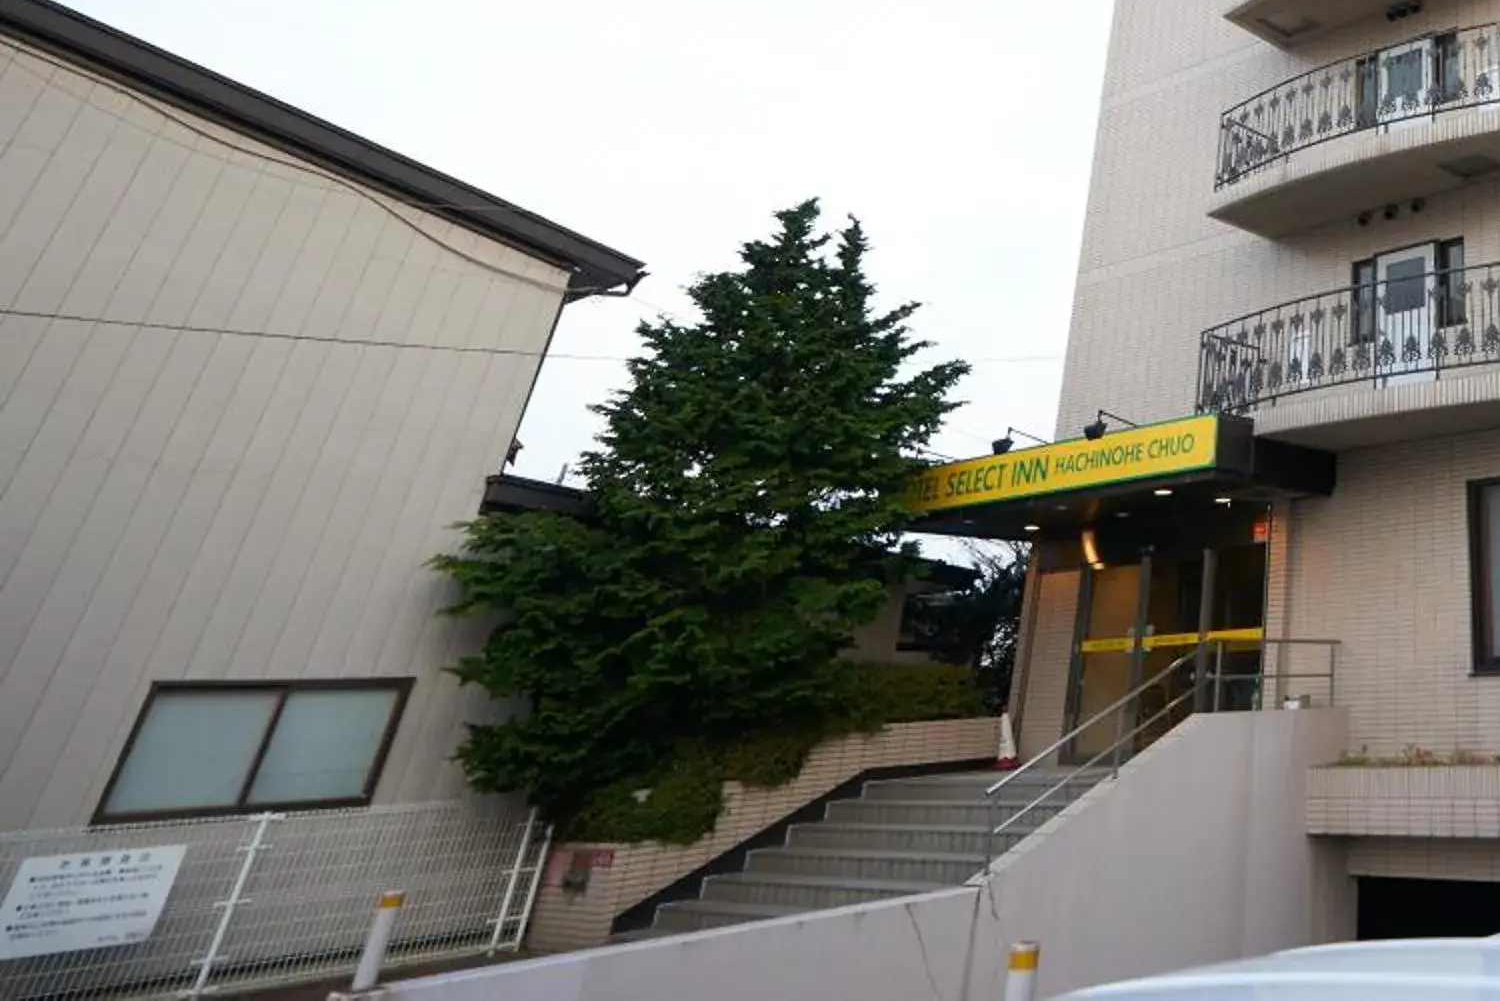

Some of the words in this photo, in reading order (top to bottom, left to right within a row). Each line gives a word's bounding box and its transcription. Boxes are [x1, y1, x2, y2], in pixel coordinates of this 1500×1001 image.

[903, 476, 940, 502] OTEL
[946, 464, 1007, 497] SELECT
[1011, 456, 1049, 488] INN
[1054, 442, 1144, 474] HACHINOHE
[1147, 433, 1195, 457] CHUO
